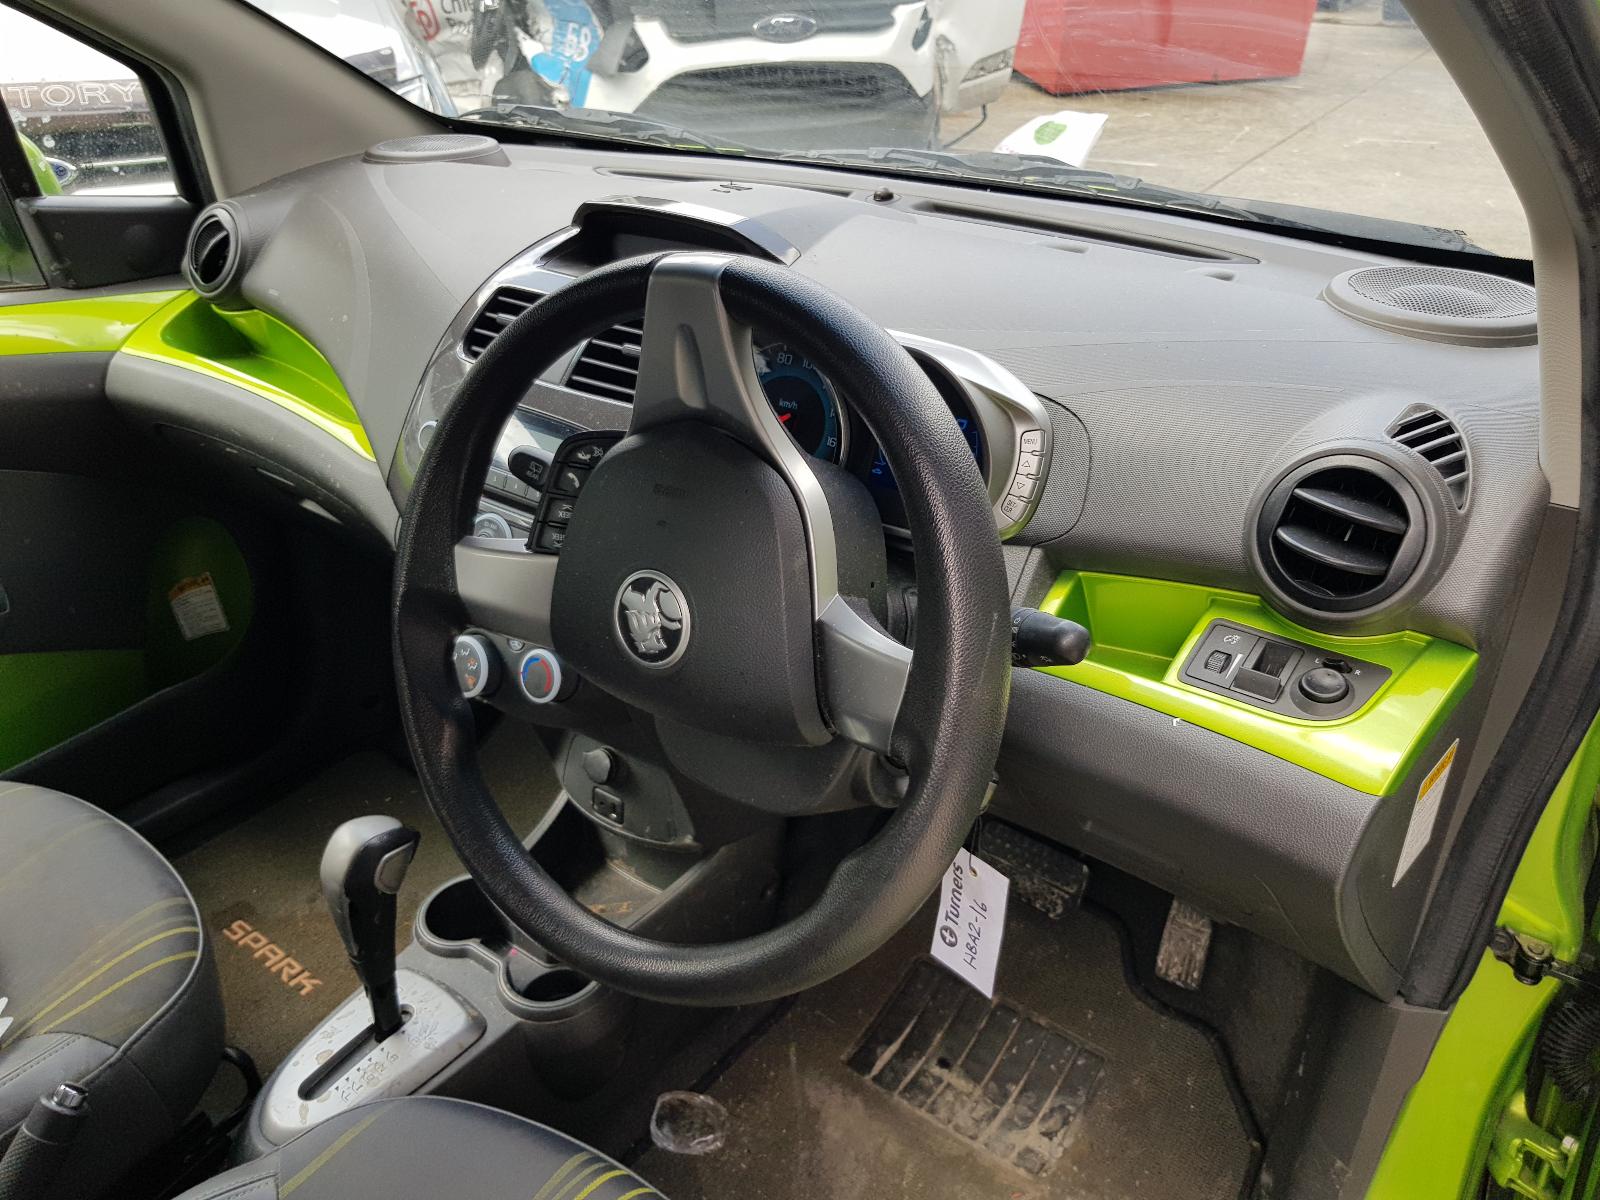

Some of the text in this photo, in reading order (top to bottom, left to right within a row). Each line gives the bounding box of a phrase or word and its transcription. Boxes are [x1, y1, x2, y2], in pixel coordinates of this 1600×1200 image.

[0, 82, 138, 109] TORY
[777, 352, 793, 365] 80
[779, 399, 798, 409] km/h
[945, 862, 963, 926] Turners
[963, 898, 987, 970] HBA2-16
[222, 919, 322, 996] SPARK
